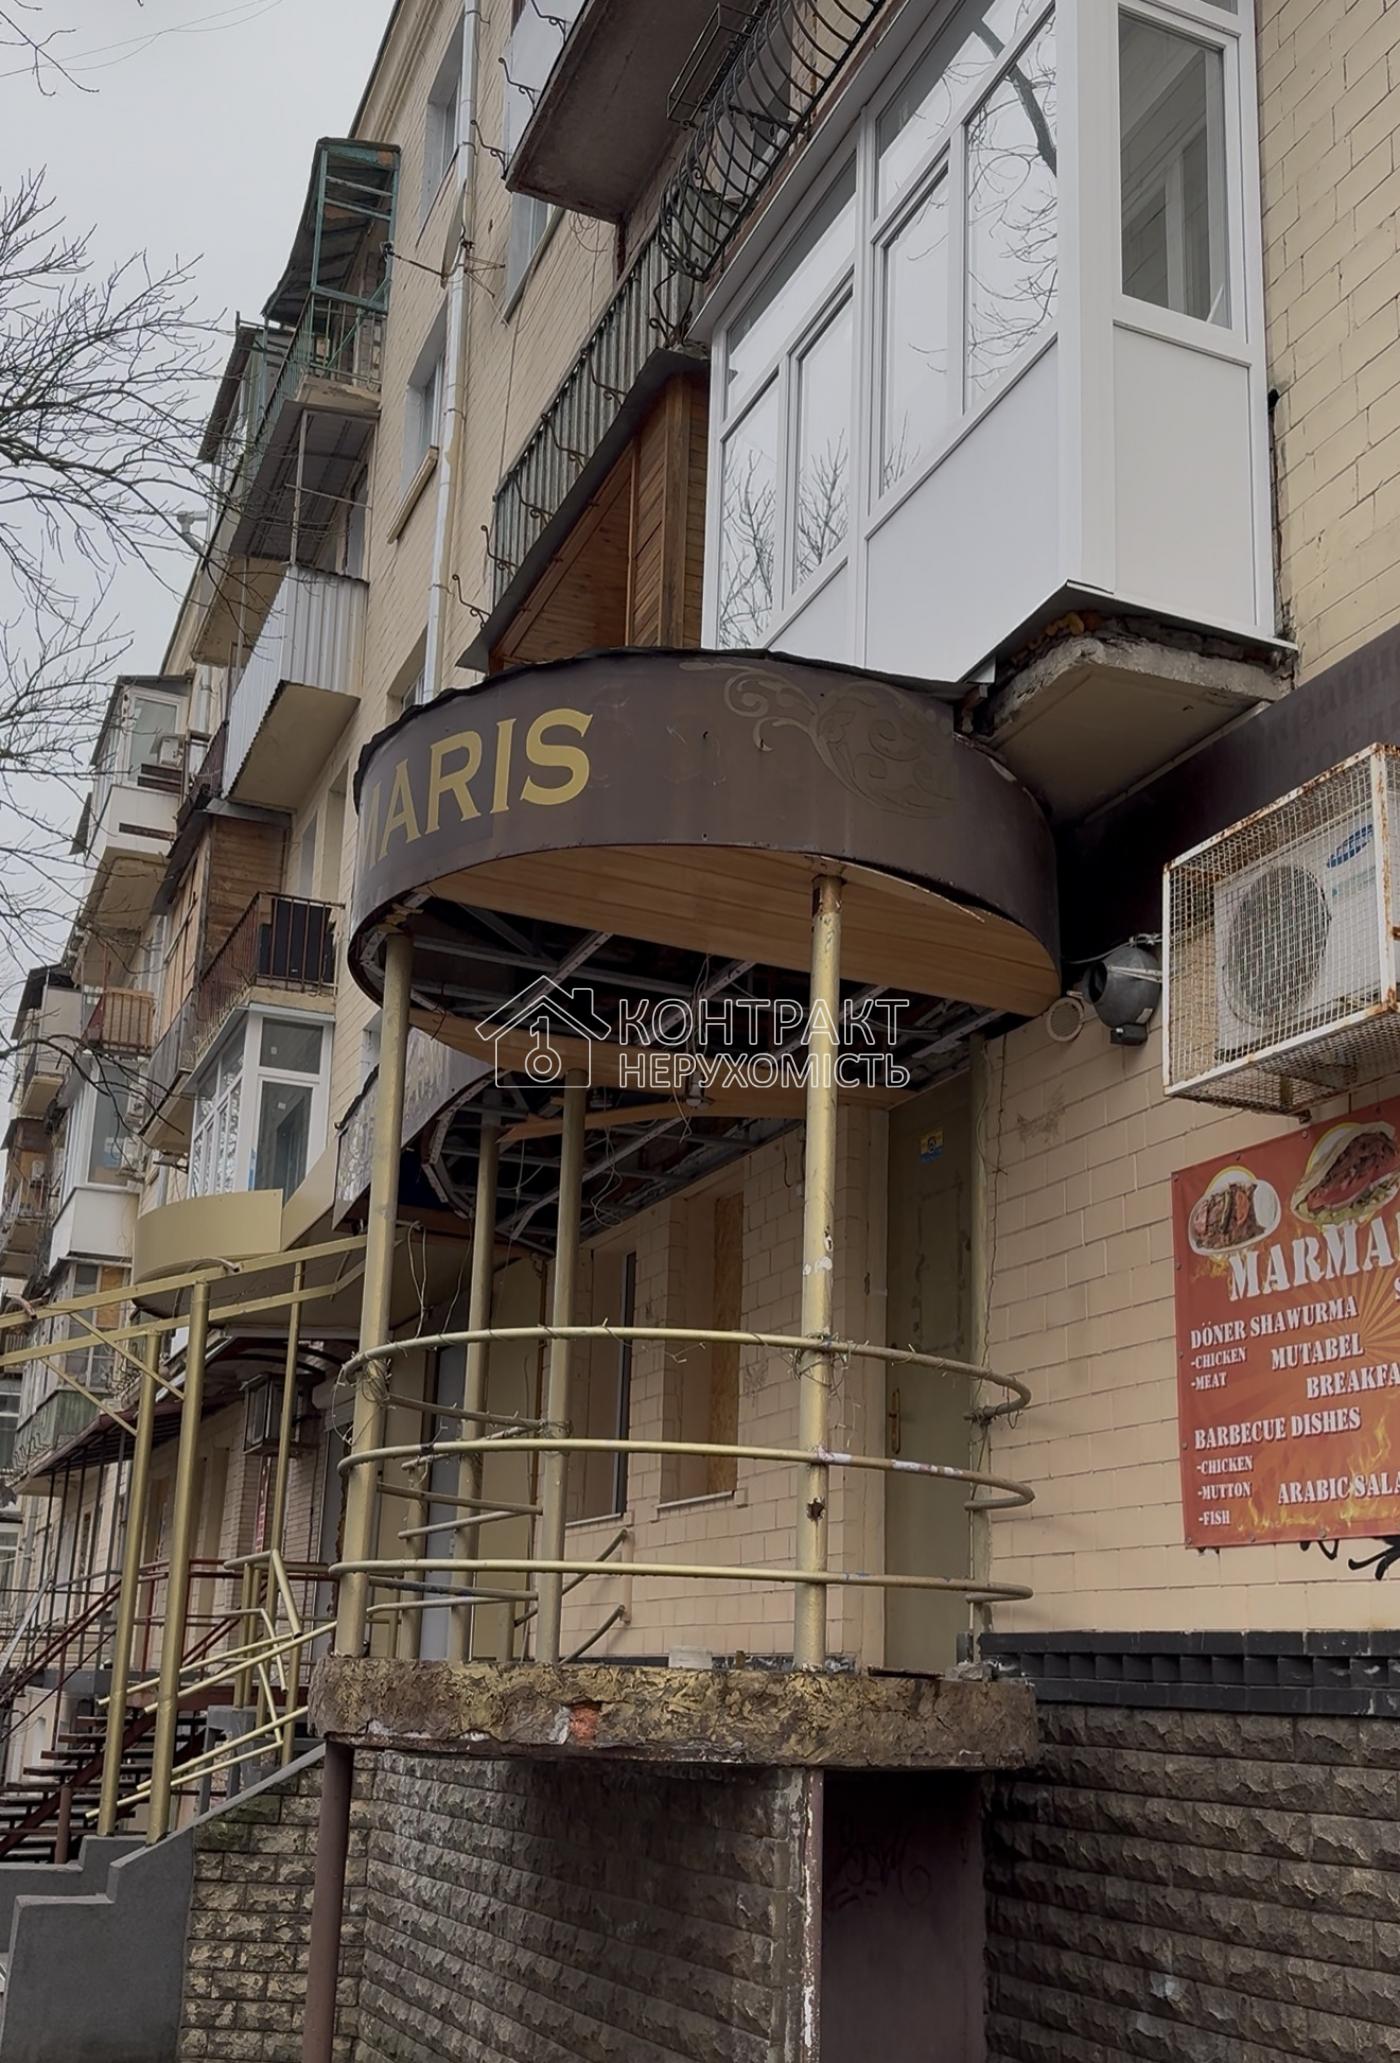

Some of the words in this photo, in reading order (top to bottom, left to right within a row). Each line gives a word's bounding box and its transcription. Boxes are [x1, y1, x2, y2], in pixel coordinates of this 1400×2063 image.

[1228, 1211, 1400, 1301] MARMA
[1190, 1320, 1246, 1349] DÖNER
[1250, 1296, 1358, 1338] SHAWURMA
[1190, 1348, 1247, 1369] -CHICKEN
[1271, 1333, 1364, 1370] MUTABEL
[1191, 1373, 1227, 1390] -MEAT
[1194, 1414, 1288, 1451] BARBECUE
[1291, 1407, 1361, 1437] DISHES
[1196, 1455, 1254, 1475] -CHICKEN
[1197, 1481, 1253, 1500] -MUTTON
[1278, 1474, 1349, 1505] ARABIC
[1197, 1509, 1231, 1526] -FISH
